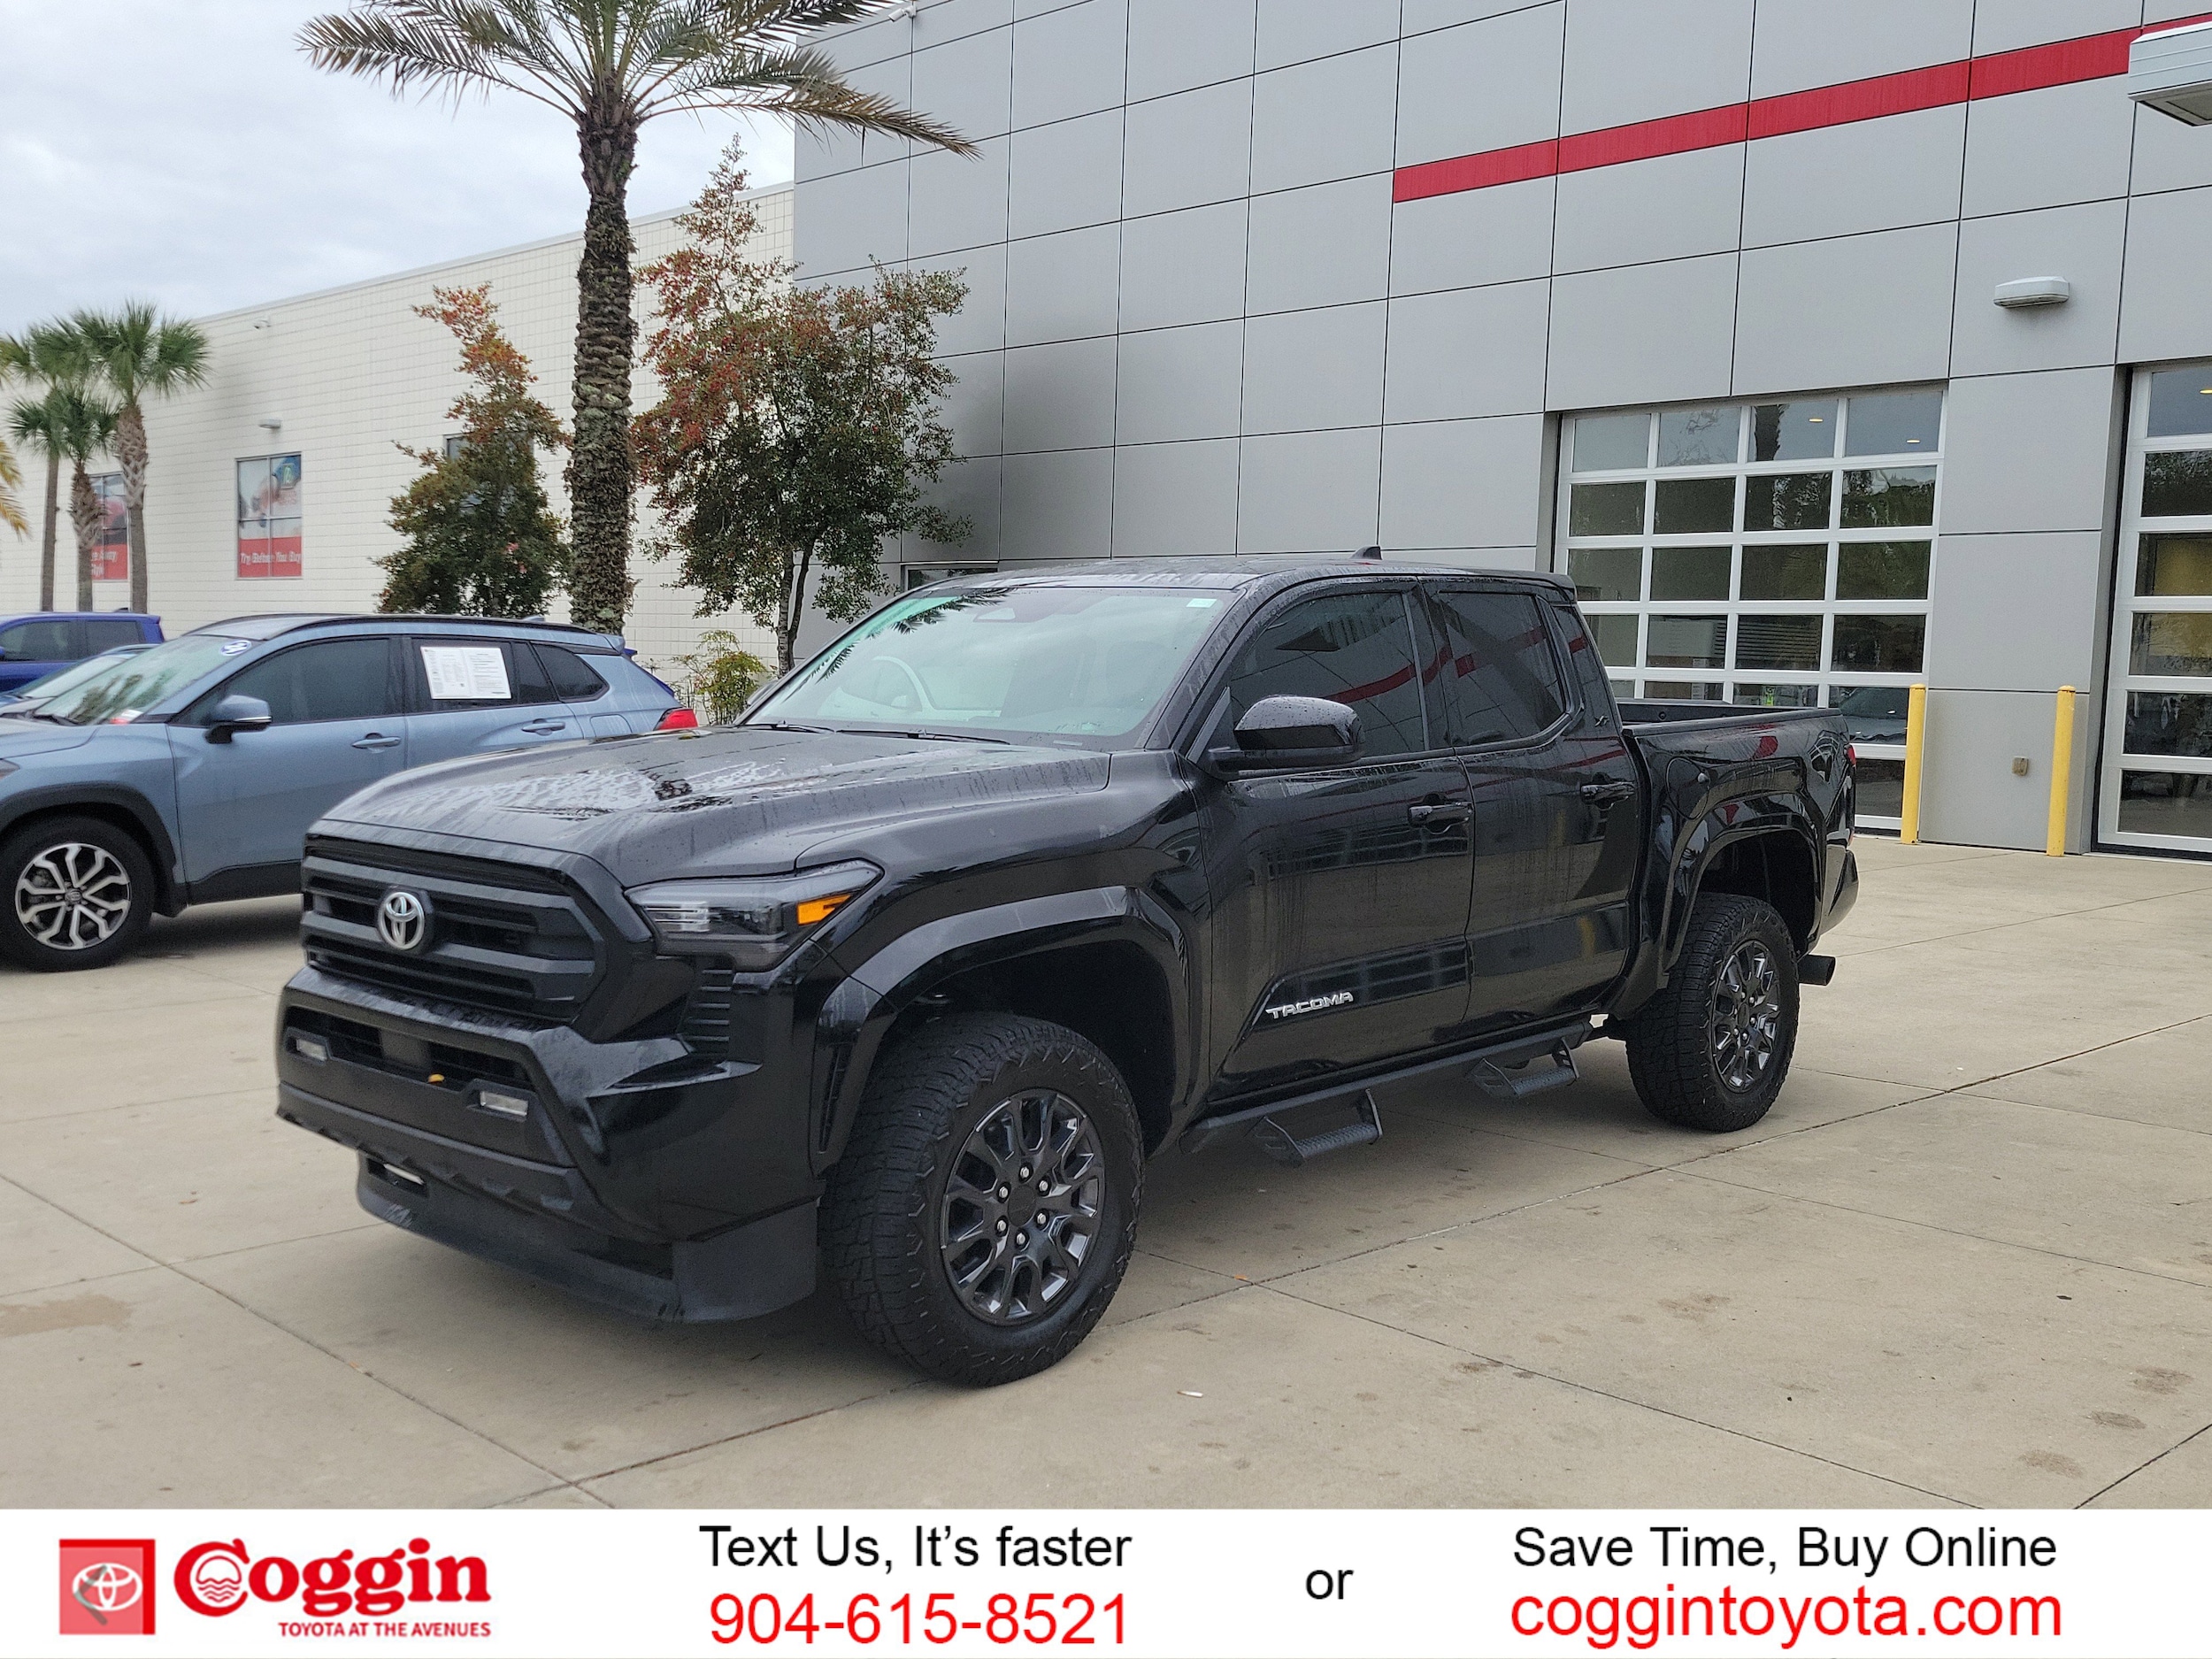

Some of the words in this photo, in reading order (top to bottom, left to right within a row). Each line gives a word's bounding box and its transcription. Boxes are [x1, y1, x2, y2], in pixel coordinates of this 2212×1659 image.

[241, 552, 251, 565] Try
[276, 551, 288, 563] You
[288, 550, 302, 565] Buy
[1265, 991, 1355, 1020] TACOMA
